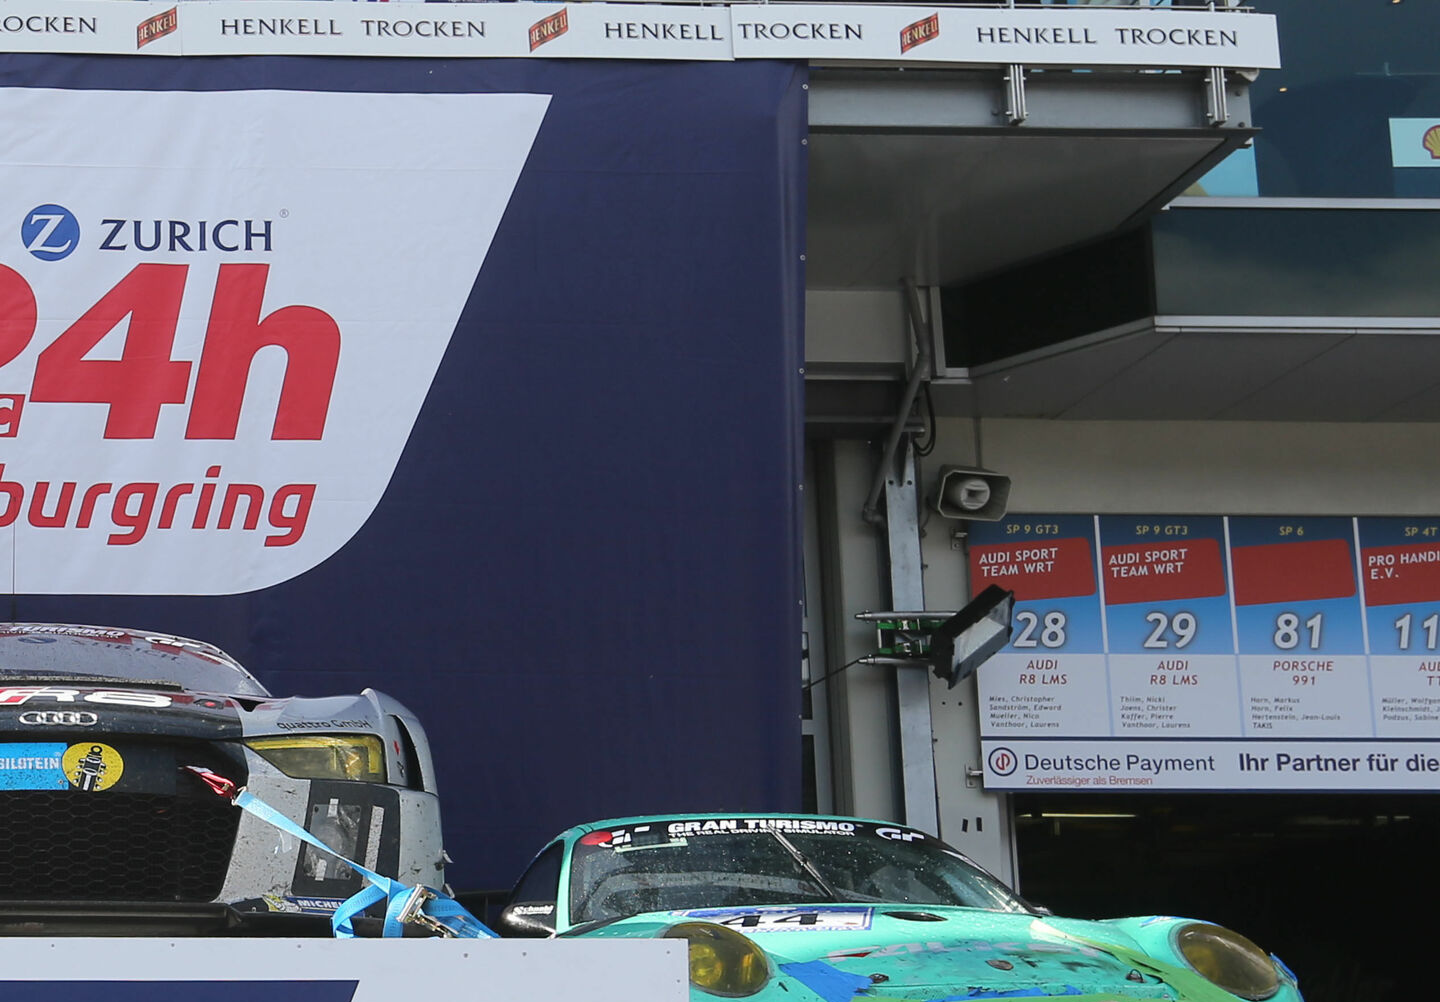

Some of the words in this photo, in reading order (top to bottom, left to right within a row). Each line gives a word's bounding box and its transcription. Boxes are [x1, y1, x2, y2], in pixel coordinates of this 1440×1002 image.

[220, 17, 343, 37] HENKELL
[360, 19, 487, 38] TROCKEN
[604, 22, 725, 41] HENKELL
[737, 22, 864, 41] TROCKEN
[976, 25, 1098, 45] HENKELL
[1114, 27, 1239, 47] TROCKEN
[100, 218, 272, 252] ZURICH
[1006, 524, 1022, 535] SP
[1024, 524, 1031, 535] 9
[1035, 524, 1059, 535] GT3
[1136, 525, 1149, 536] SP
[1153, 525, 1160, 536] 9
[1164, 525, 1188, 536] GT3
[1279, 526, 1293, 536] SP
[1297, 526, 1304, 536] 6
[1405, 527, 1419, 537] SP
[1422, 527, 1438, 537] 4T
[979, 552, 1010, 565] AUDI
[1015, 548, 1058, 562] SPORT
[1109, 552, 1140, 566] AUDI
[1145, 549, 1188, 562] SPORT
[1368, 554, 1395, 567] PRO
[982, 564, 1019, 578] TEAM
[1024, 561, 1054, 574] WRT
[1111, 565, 1149, 579] TEAM
[1154, 562, 1184, 575] WRT
[1370, 567, 1400, 580] E.V.
[1013, 611, 1067, 648] 28
[1144, 611, 1197, 648] 29
[1273, 612, 1323, 650] 81
[1027, 659, 1058, 671] AUDI
[1157, 660, 1188, 671] AUDI
[1273, 660, 1334, 672] PORSCHE
[1019, 674, 1036, 684] R8
[1042, 674, 1067, 685] LMS
[1150, 675, 1166, 685] R8
[1172, 675, 1198, 686] LMS
[1292, 675, 1316, 686] 991
[277, 720, 331, 730] quattro
[331, 719, 373, 729] GmbH
[1025, 754, 1121, 771] Deutsche
[1126, 754, 1215, 775] Payment
[1239, 753, 1270, 772] Ihr
[1276, 753, 1361, 772] Partner
[1367, 753, 1399, 772] für
[1406, 753, 1439, 772] die
[1026, 775, 1090, 786] Zuverlässiger
[1093, 775, 1107, 785] als
[1109, 775, 1153, 785] Bremsen
[668, 820, 737, 833] GRAN
[744, 819, 855, 832] TURISMO
